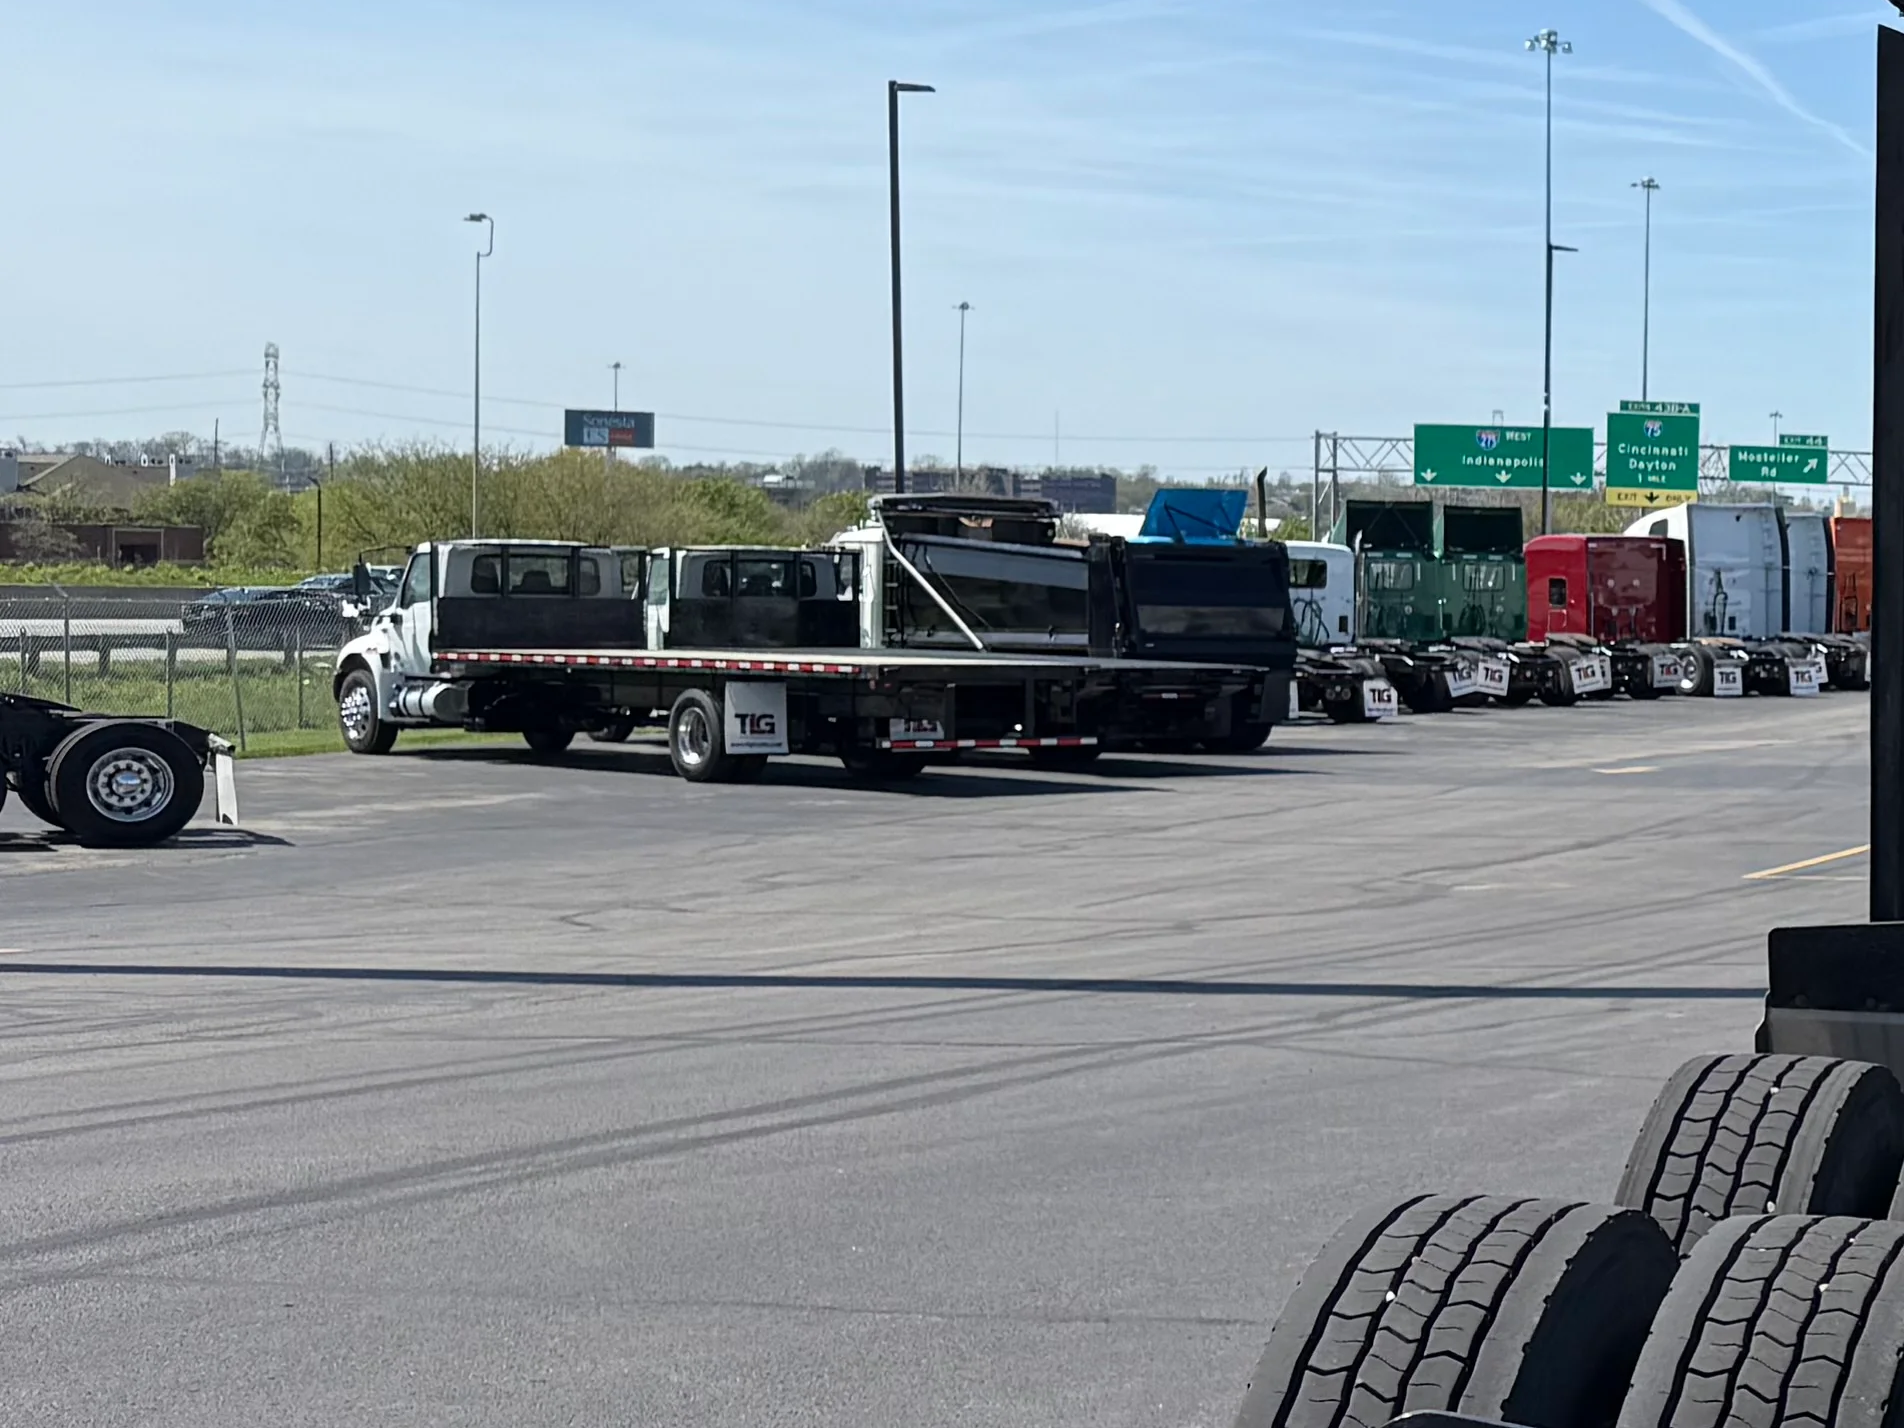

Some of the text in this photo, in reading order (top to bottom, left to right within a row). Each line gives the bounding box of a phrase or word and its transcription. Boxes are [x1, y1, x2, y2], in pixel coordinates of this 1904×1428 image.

[1505, 431, 1532, 442] WEST
[1617, 442, 1688, 457] Cincinnati
[1737, 450, 1799, 464] Mosteller
[1628, 458, 1677, 472] Dayton
[1760, 465, 1777, 478] Rd
[734, 712, 776, 735] TLG
